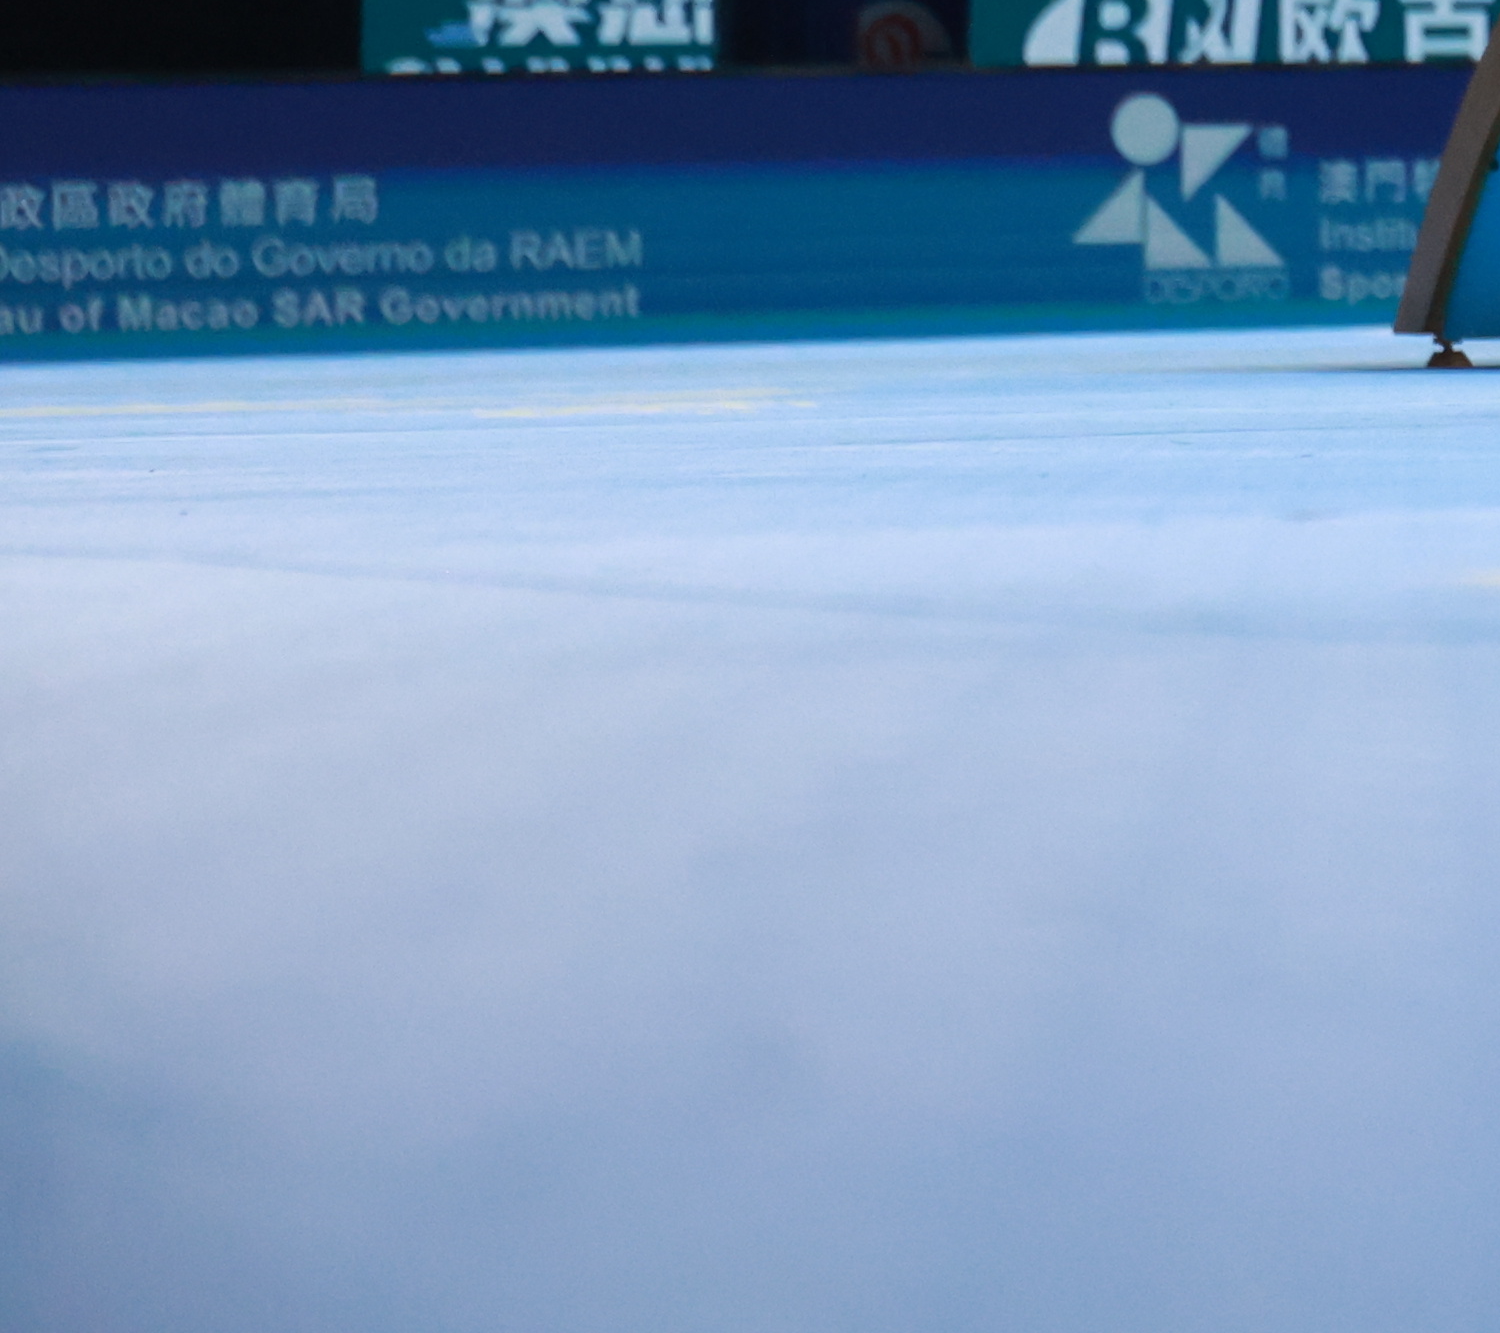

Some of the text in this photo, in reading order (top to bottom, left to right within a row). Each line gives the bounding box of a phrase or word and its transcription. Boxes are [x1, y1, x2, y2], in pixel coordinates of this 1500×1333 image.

[185, 233, 240, 278] do
[252, 231, 434, 278] Governo
[444, 231, 497, 274] da
[510, 229, 643, 271] RAEM
[60, 291, 102, 333] of
[118, 294, 259, 332] Macao
[272, 286, 365, 327] SAR
[380, 281, 641, 325] Government
